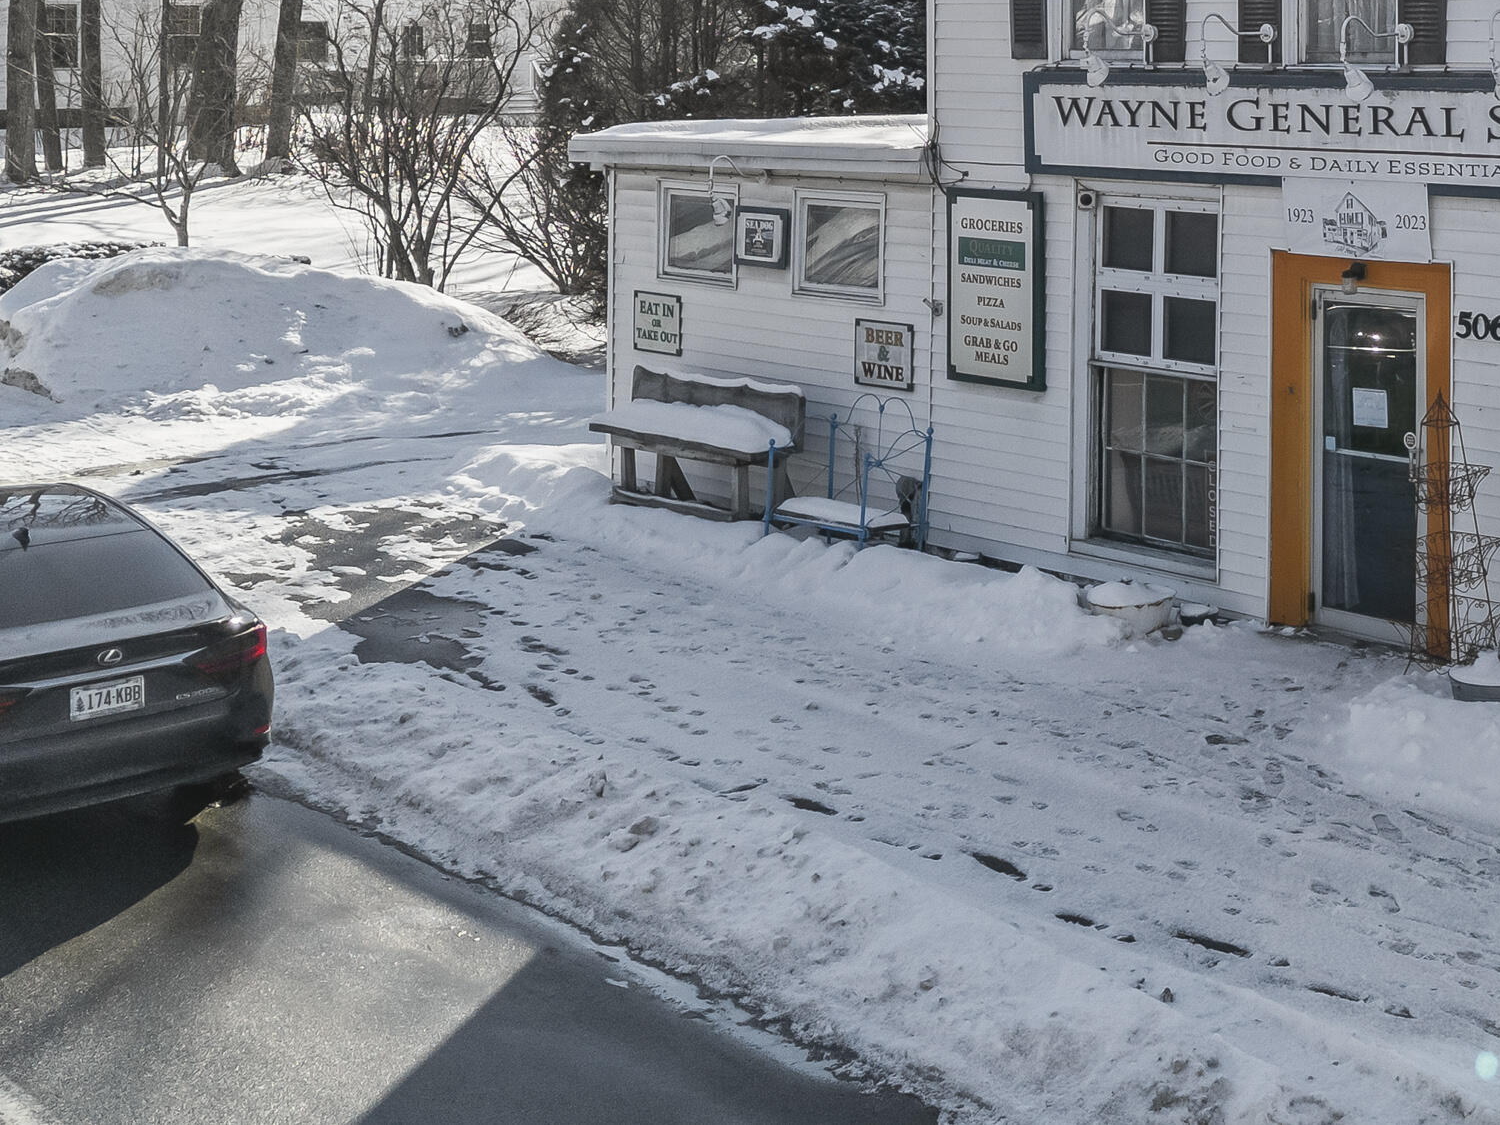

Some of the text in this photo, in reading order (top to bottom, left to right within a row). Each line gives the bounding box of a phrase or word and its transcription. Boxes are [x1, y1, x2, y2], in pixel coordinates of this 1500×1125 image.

[1051, 95, 1207, 132] WAYNE
[1226, 96, 1465, 143] GENERAL
[1154, 149, 1214, 165] GOOD
[1222, 151, 1281, 169] FOOD
[1289, 157, 1302, 170] &
[1310, 157, 1380, 174] DAILY
[1287, 208, 1314, 224] 1923
[1395, 214, 1427, 231] 2023
[960, 217, 1023, 234] GROCERIES
[969, 240, 1014, 257] QUALITY
[960, 272, 1021, 289] SANDWICHES
[640, 300, 674, 318] EAT IN
[977, 296, 1005, 309] PIZZA
[651, 318, 662, 328] OR
[636, 327, 678, 344] TAKE OUT
[864, 327, 904, 347] BEER
[964, 335, 1018, 353] GRAB & GO
[877, 345, 889, 362] &
[974, 351, 1009, 366] MEALS
[861, 361, 904, 382] WINE
